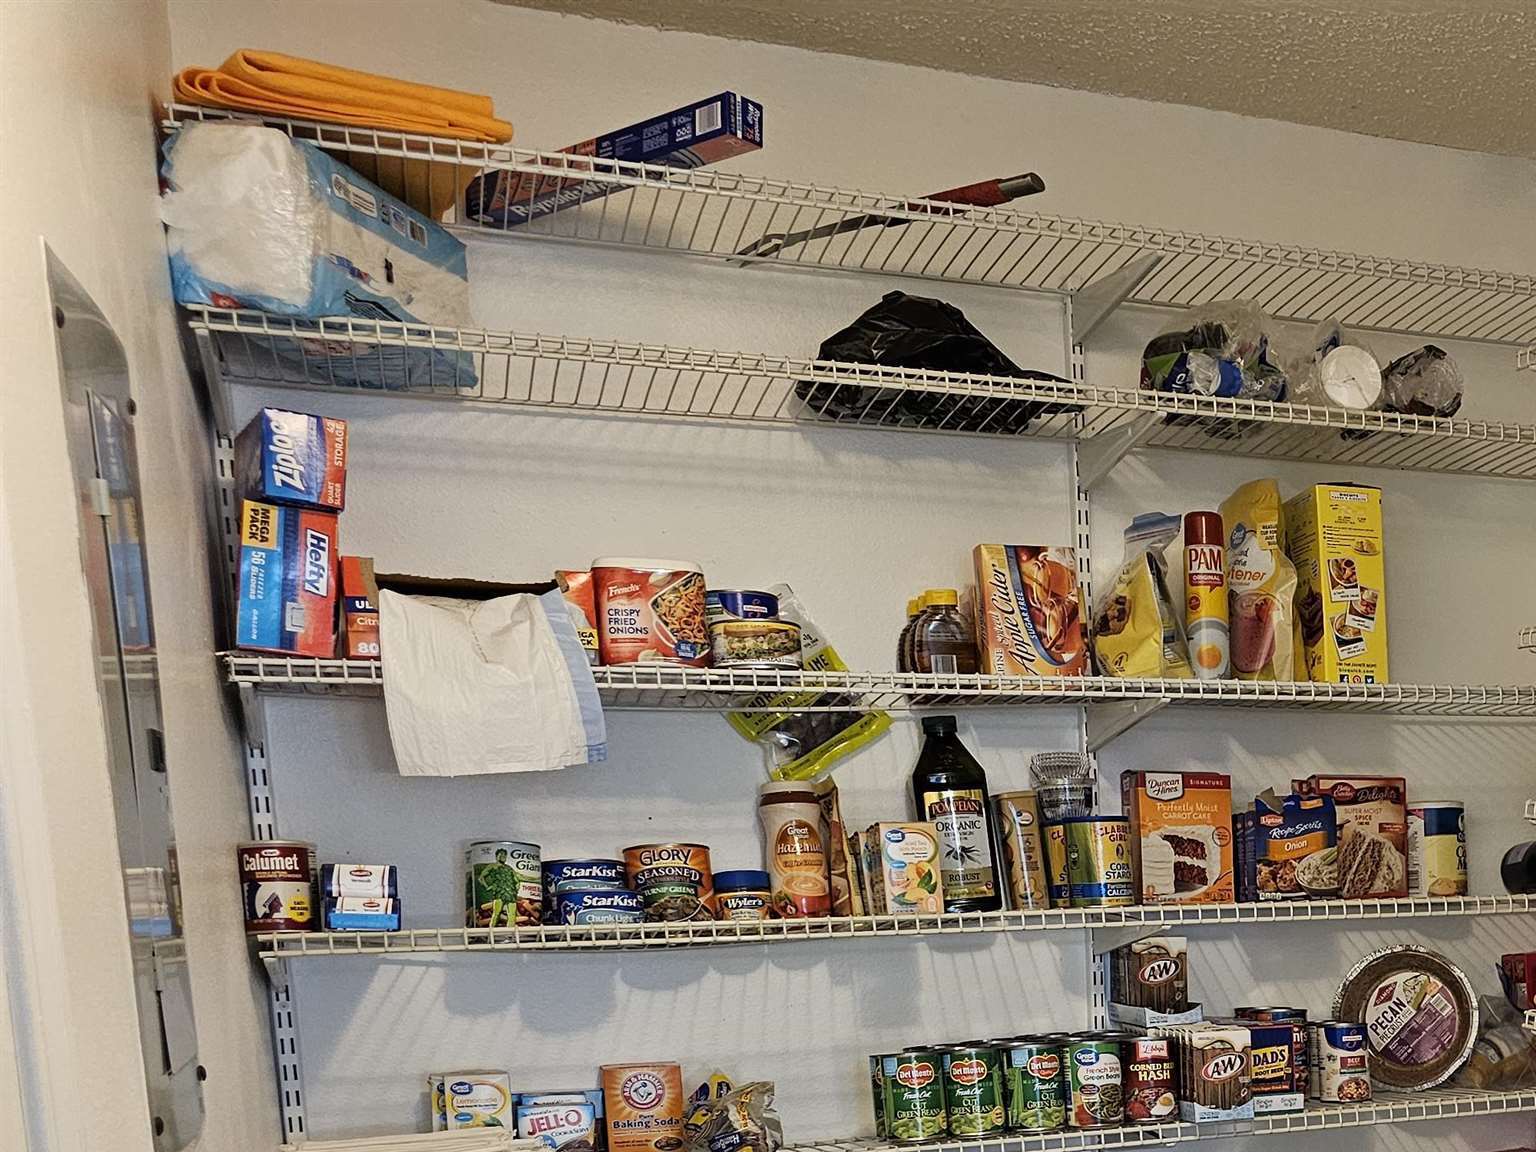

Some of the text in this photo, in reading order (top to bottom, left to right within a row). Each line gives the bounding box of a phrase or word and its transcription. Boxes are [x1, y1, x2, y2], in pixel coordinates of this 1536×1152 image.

[334, 421, 347, 467] STORAGE
[268, 420, 307, 491] Ziploc
[249, 508, 260, 542] PACK
[259, 508, 270, 544] MEGA
[306, 532, 327, 593] Hefty
[1188, 547, 1224, 573] PAM
[988, 565, 1015, 615] Cider
[607, 607, 641, 618] CRISPY
[1014, 590, 1038, 640] SUGAR FREE
[607, 616, 637, 626] FRIED
[608, 625, 649, 635] ONIONS
[1004, 615, 1040, 675] Apple
[1147, 778, 1180, 788] Duncan
[1152, 786, 1179, 794] Hines
[1156, 802, 1194, 813] Perfectly
[1162, 812, 1212, 820] CARROT CAKE
[935, 820, 981, 831] ORGANIC
[1108, 833, 1128, 841] GIRL
[1269, 826, 1295, 840] Recipe
[1284, 839, 1308, 851] Onion
[243, 853, 300, 871] Calumet
[639, 849, 693, 867] GLORY
[561, 866, 617, 878] StarKist
[637, 866, 700, 884] SEASONED
[949, 872, 981, 881] ROBUST
[669, 885, 695, 896] GREENS
[582, 895, 638, 907] StarKist
[726, 897, 763, 908] Wyler's
[586, 914, 634, 924] Chunk Light
[1369, 997, 1408, 1034] PECAN
[1252, 1047, 1287, 1066] DAD'S
[1129, 1063, 1162, 1072] CORNED
[1138, 1070, 1170, 1081] HASH
[613, 1117, 680, 1130] Baking Soda
